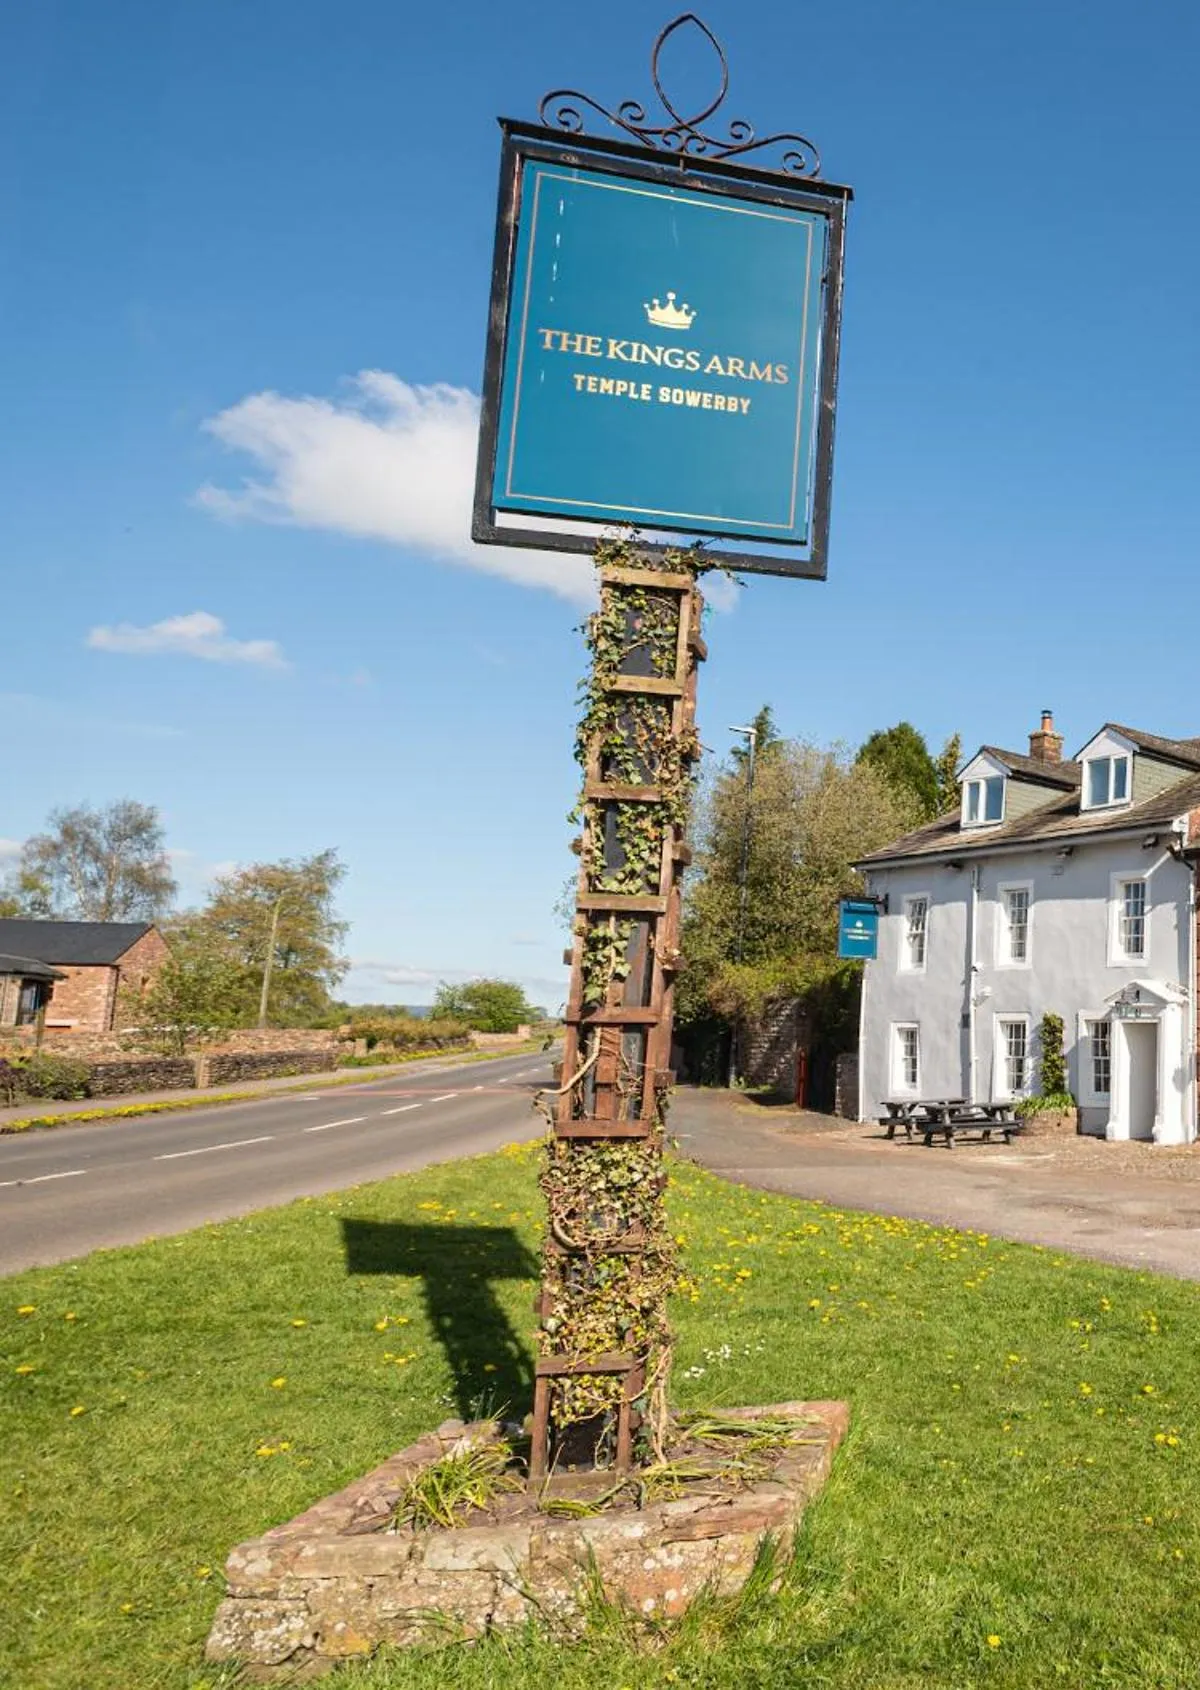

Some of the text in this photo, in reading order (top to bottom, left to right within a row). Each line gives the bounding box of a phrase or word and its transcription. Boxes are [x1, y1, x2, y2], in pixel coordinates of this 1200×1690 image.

[538, 329, 789, 384] THE KINGS ARMS
[574, 374, 751, 414] TEMPLE SOWERBY
